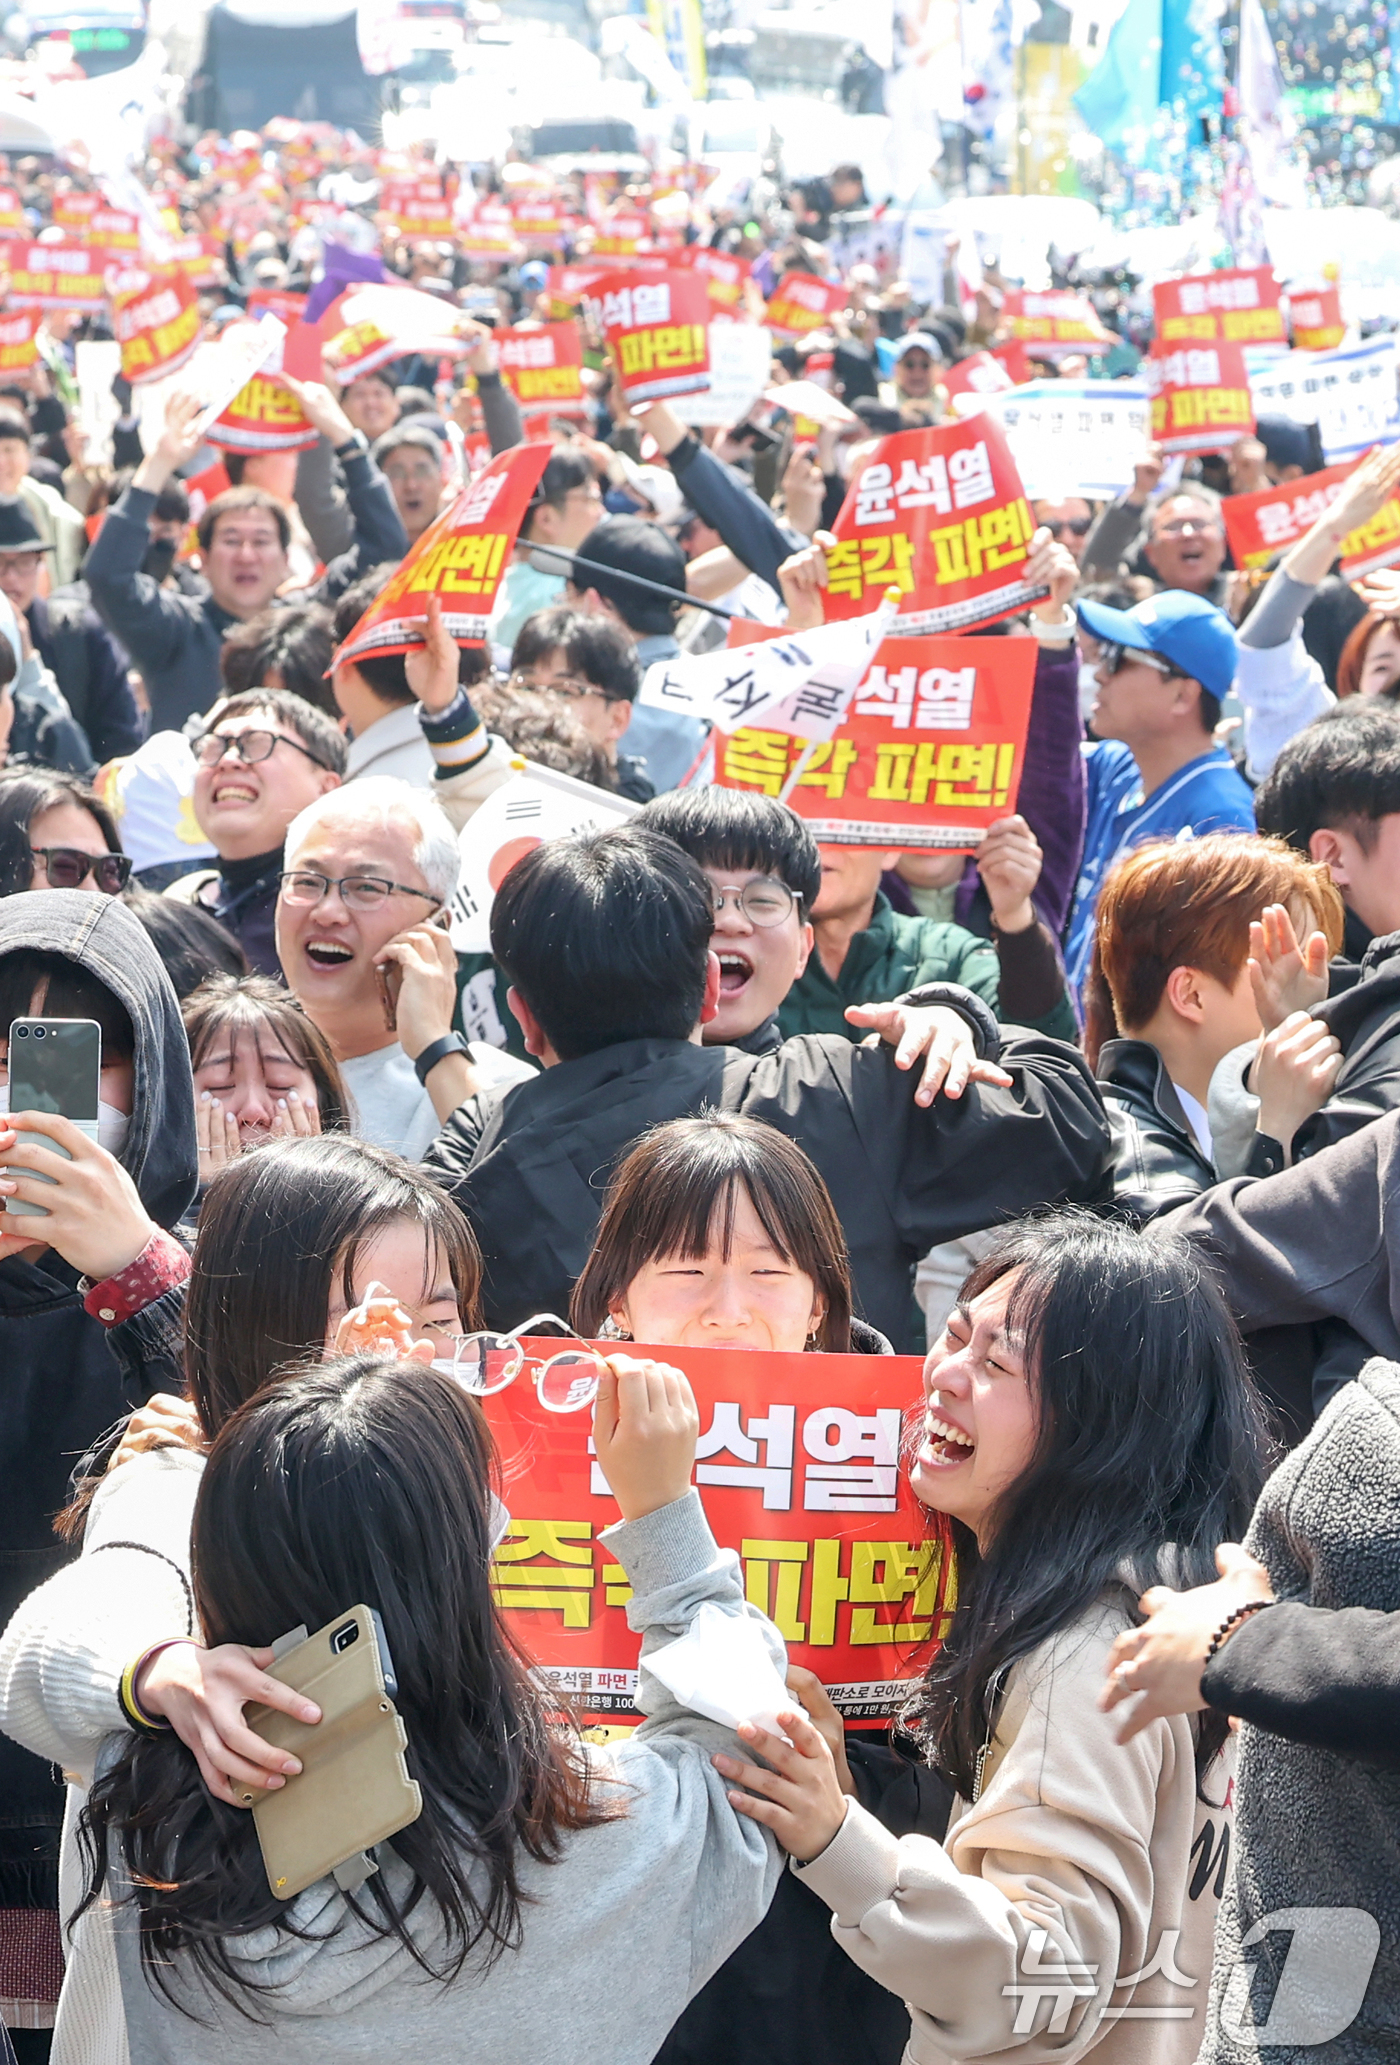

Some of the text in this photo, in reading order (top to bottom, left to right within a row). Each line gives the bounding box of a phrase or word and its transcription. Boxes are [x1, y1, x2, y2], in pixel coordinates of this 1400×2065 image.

[619, 324, 705, 375] 파면!
[855, 440, 996, 526] 윤석열
[824, 532, 916, 601] 즉각
[838, 666, 976, 730] 석열
[724, 728, 1014, 807] 즉각 파면!
[588, 1402, 901, 1512] 석열
[490, 1519, 634, 1628] 즉
[549, 1671, 593, 1688] 윤석열
[598, 1673, 627, 1690] 파면
